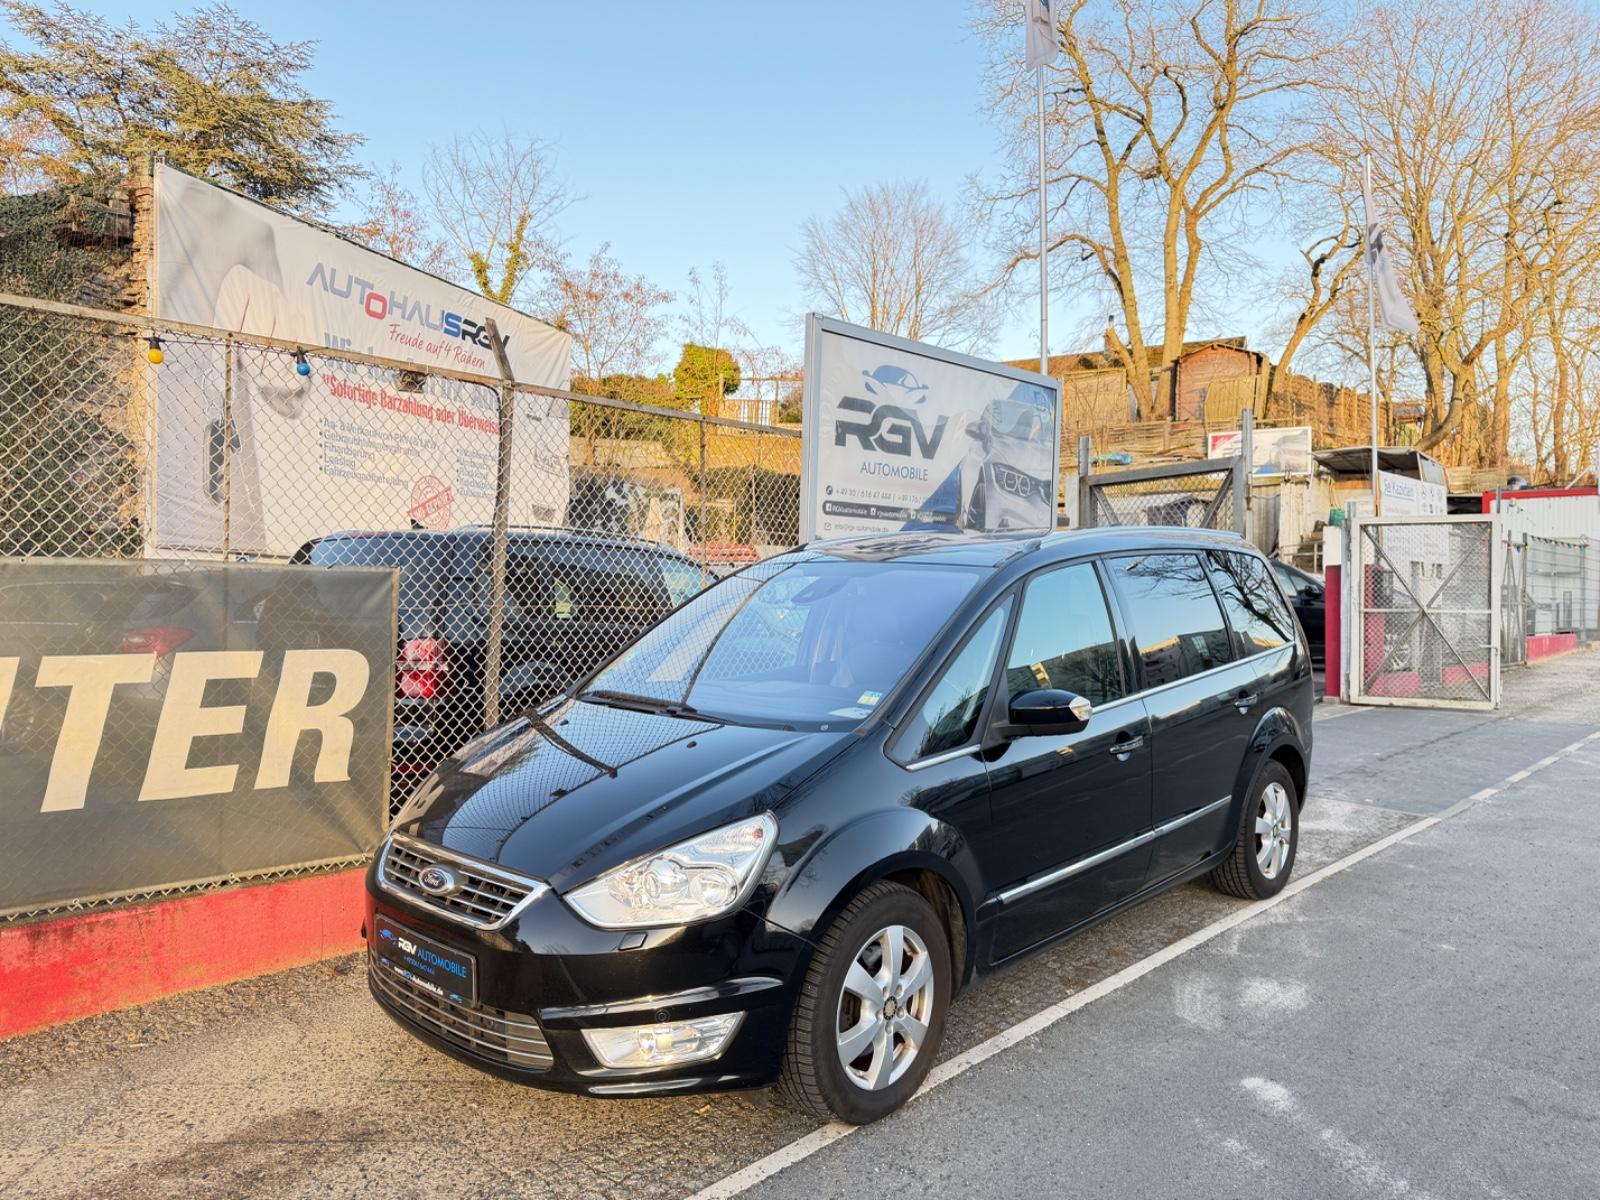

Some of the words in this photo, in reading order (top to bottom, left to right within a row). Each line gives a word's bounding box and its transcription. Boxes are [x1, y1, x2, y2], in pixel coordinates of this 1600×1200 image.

[388, 323, 423, 350] Freude
[426, 341, 443, 360] auf
[443, 342, 452, 356] 4
[454, 344, 486, 370] Rädern
[380, 389, 434, 422] Barzahlung
[834, 395, 949, 460] RGV
[860, 461, 929, 481] AUTOMOBILE
[0, 648, 371, 813] TER
[424, 872, 441, 887] Ford
[398, 937, 417, 955] RGV
[418, 948, 467, 978] AUTOMOBILE
